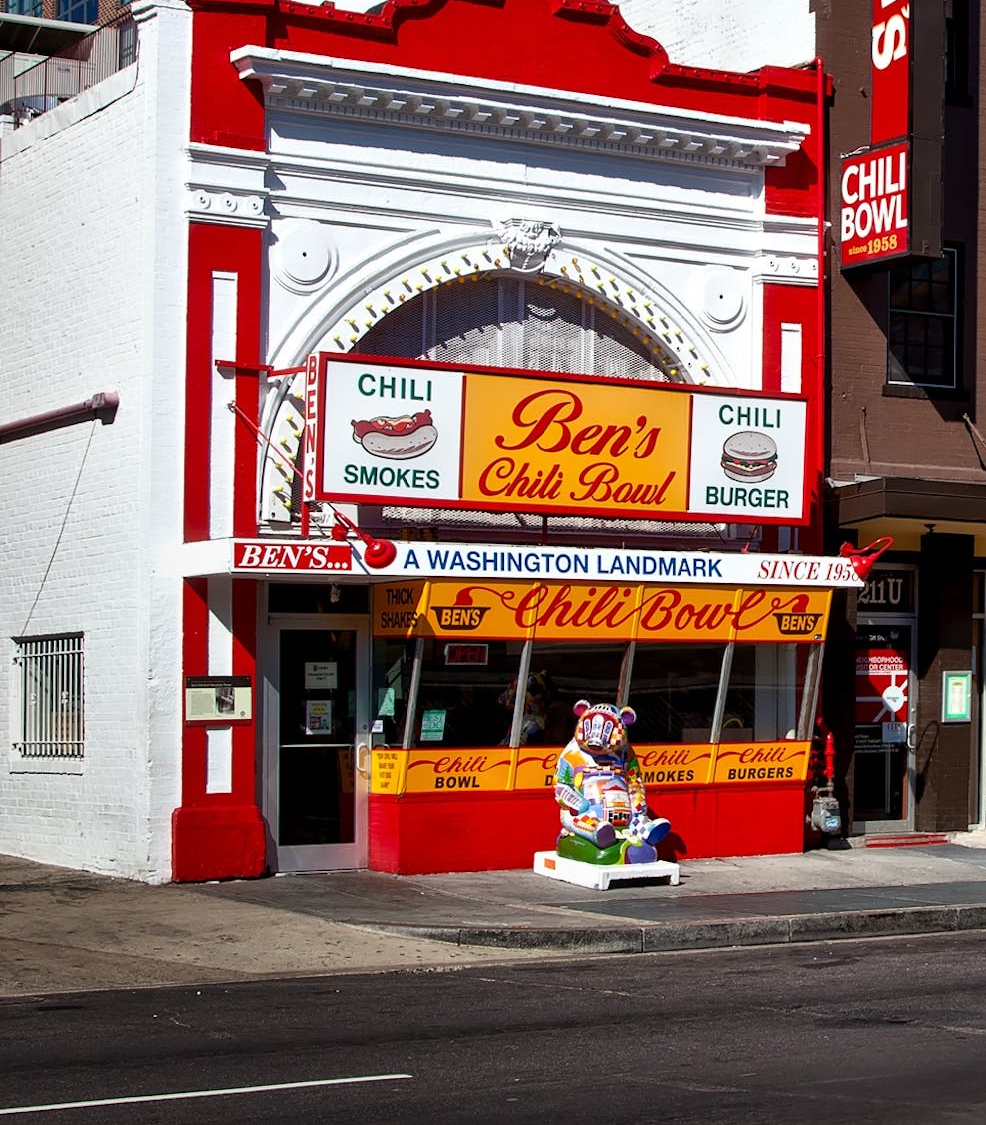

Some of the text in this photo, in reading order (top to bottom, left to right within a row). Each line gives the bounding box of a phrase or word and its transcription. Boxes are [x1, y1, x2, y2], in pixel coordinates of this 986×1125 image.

[842, 151, 906, 202] CHILI
[842, 201, 908, 243] BOWL
[867, 234, 898, 255] 1958
[358, 373, 432, 401] CHILI
[306, 356, 318, 498] BEN'S
[495, 389, 661, 459] Ben's
[719, 404, 781, 429] CHILI
[344, 464, 440, 490] SMOKES
[478, 456, 676, 505] Chili Bowl
[706, 486, 790, 509] BURGER
[403, 549, 420, 570] A
[426, 549, 588, 574] WASHINGTON
[597, 557, 722, 578] LANDMARK
[757, 559, 821, 580] SINCE
[386, 588, 414, 605] THICK
[514, 584, 772, 631] Chili Bowl
[381, 611, 418, 629] SHAKES
[440, 608, 481, 626] BEN'S
[781, 614, 816, 632] BEN'S
[879, 663, 904, 671] CENTER
[433, 755, 489, 774] Chili
[642, 749, 691, 767] Chili
[739, 747, 786, 763] Chili
[435, 775, 480, 789] BOWL
[728, 766, 794, 780] BURGERS
